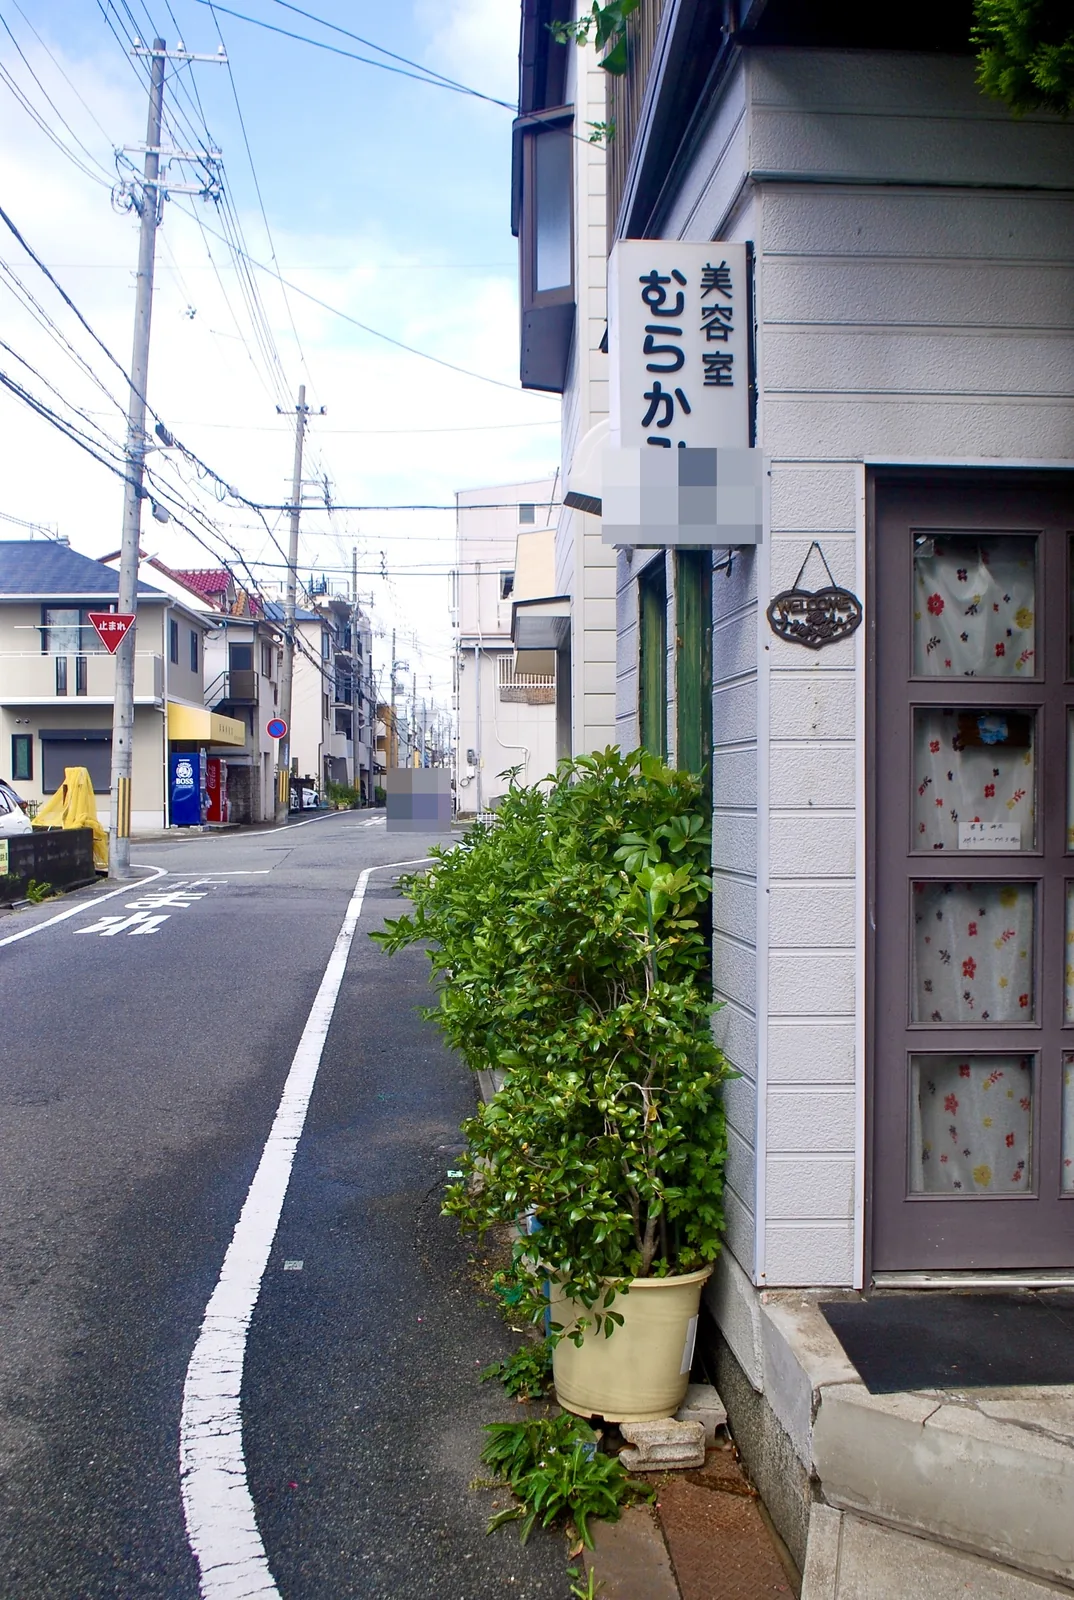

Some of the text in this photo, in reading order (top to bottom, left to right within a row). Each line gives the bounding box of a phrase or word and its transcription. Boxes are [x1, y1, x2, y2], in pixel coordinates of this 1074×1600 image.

[700, 260, 734, 387] 美容室
[777, 596, 851, 613] WELCOME
[98, 621, 126, 630] 止まれ
